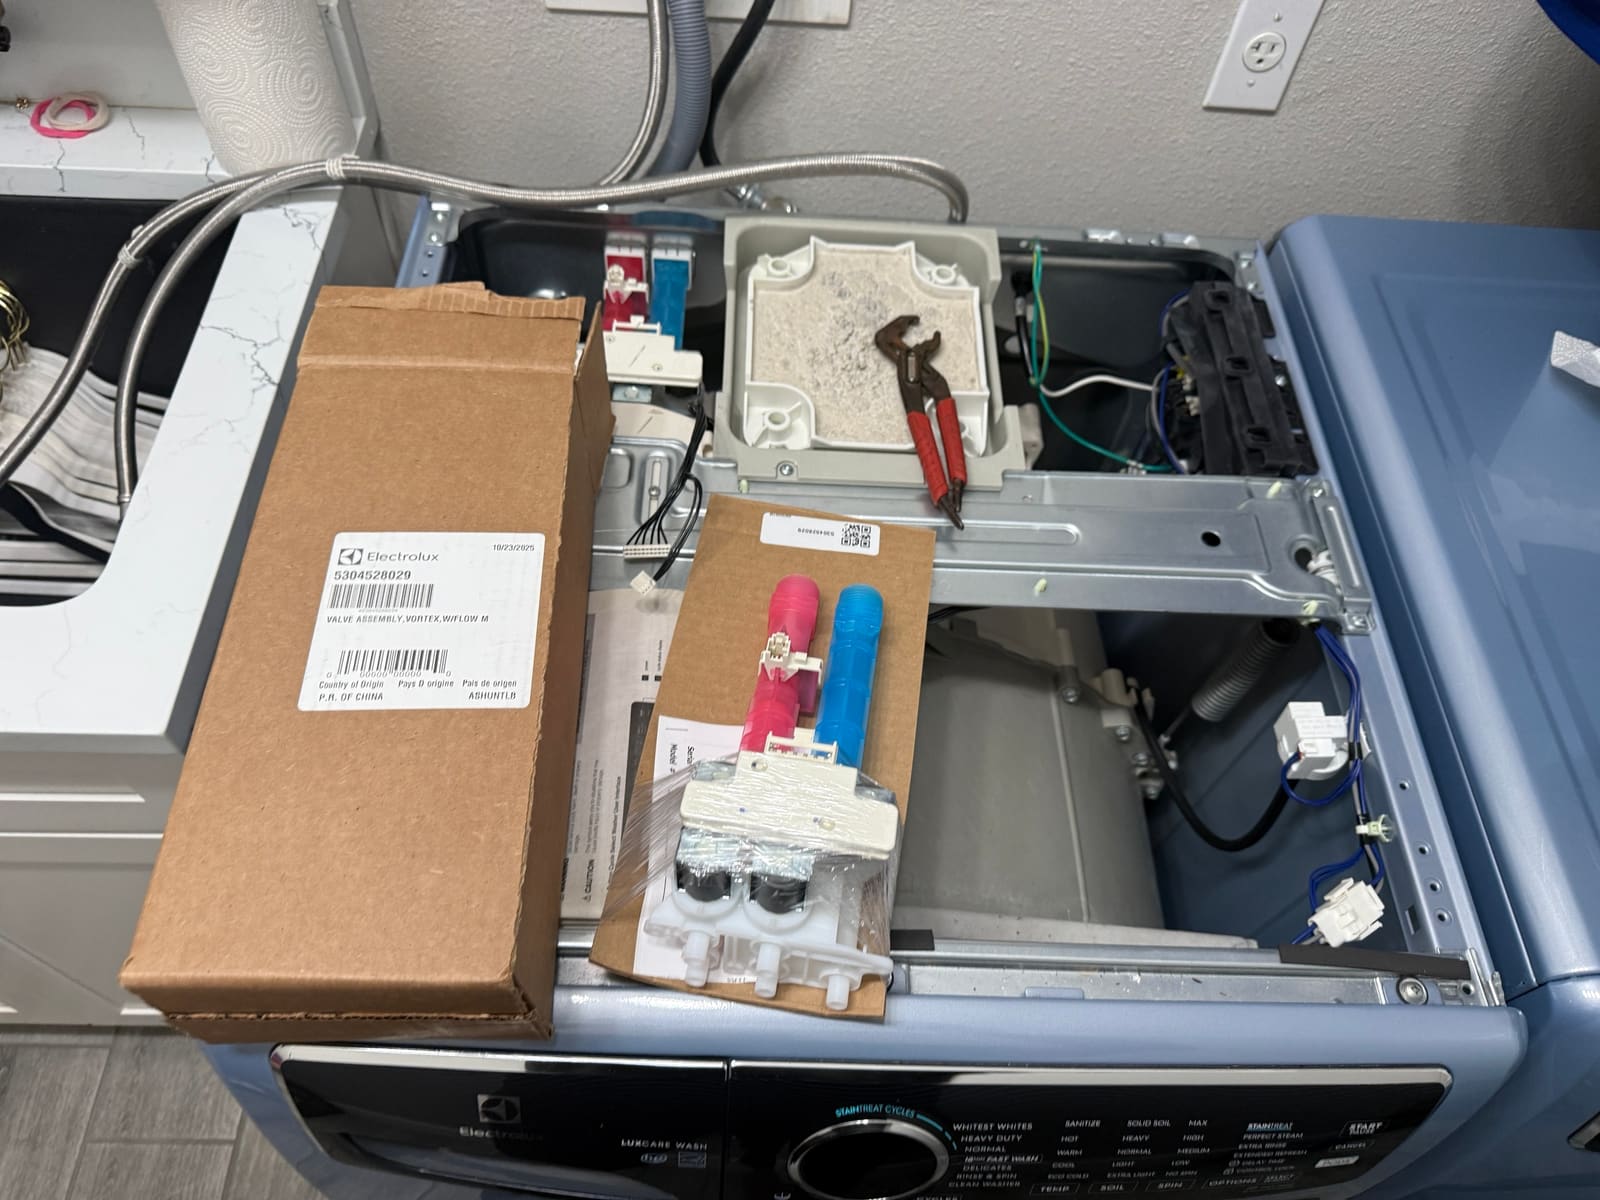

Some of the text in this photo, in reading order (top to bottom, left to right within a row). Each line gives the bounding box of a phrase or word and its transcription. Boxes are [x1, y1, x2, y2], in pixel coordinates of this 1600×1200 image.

[366, 552, 438, 562] Electrolux
[334, 570, 411, 580] 5304528029
[318, 680, 384, 690] Country of Origin
[398, 680, 416, 688] Pays
[426, 680, 454, 688] origine
[493, 680, 517, 688] origen
[341, 693, 353, 701] OF
[356, 692, 384, 701] CHINA
[670, 744, 678, 765] Model
[686, 745, 695, 764] Seria
[835, 1104, 916, 1118] STAINTREAT CYCLES
[953, 1122, 1032, 1132] WHITEST WHITES
[1065, 1120, 1100, 1128] SANITIZE
[1127, 1120, 1172, 1128] SOLID SOIL
[960, 1134, 1022, 1142] HEAVY DUTY
[676, 1140, 708, 1150] WASH
